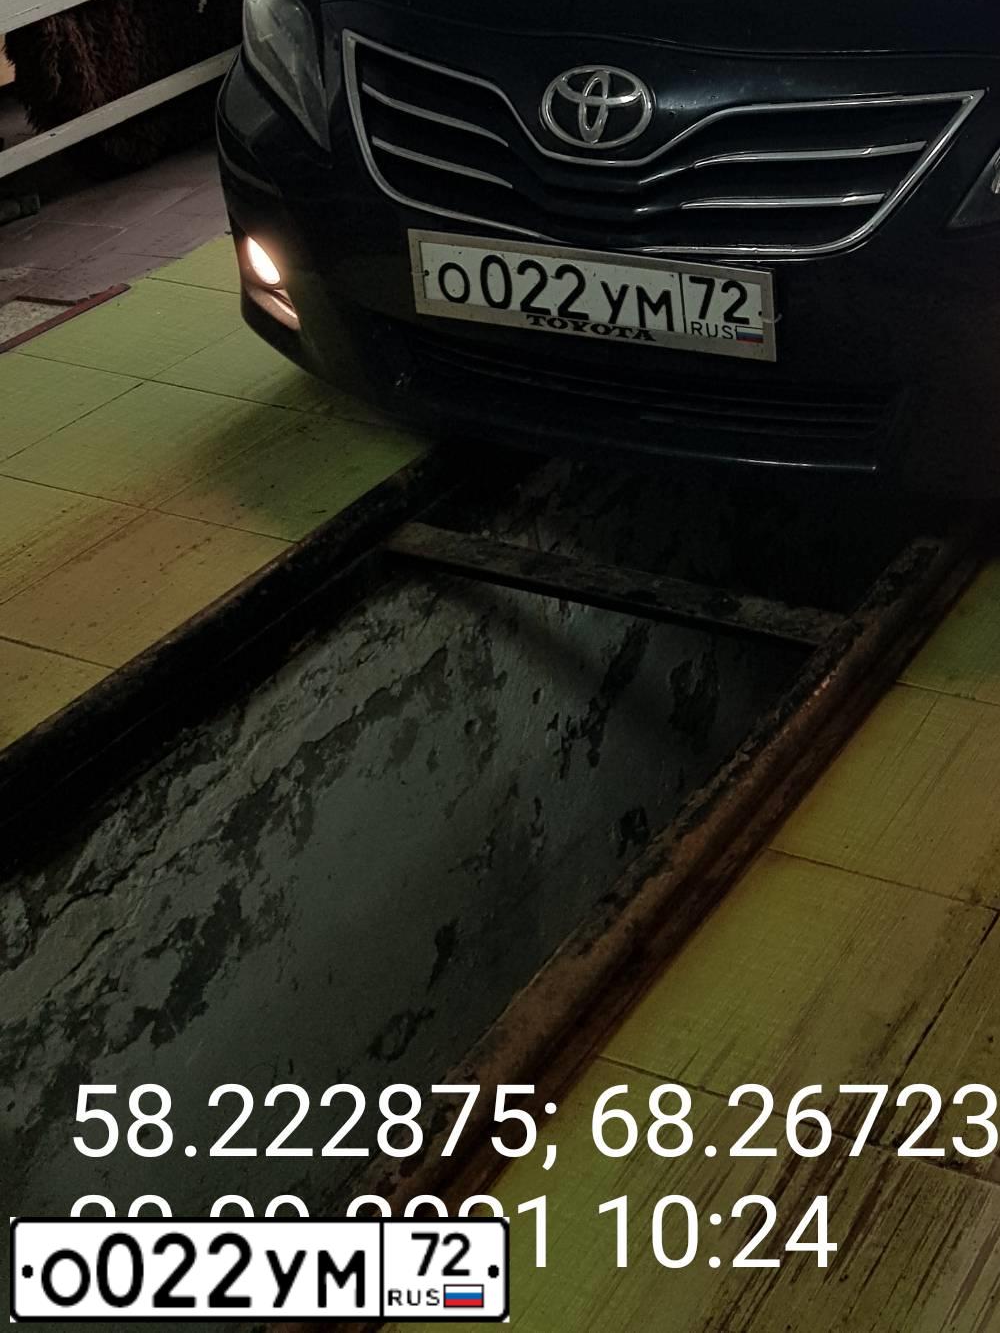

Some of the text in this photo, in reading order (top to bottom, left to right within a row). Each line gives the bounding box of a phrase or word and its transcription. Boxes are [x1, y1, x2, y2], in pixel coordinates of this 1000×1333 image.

[688, 275, 751, 325] 72
[525, 314, 657, 342] TOYOTA
[690, 320, 735, 341] RUS
